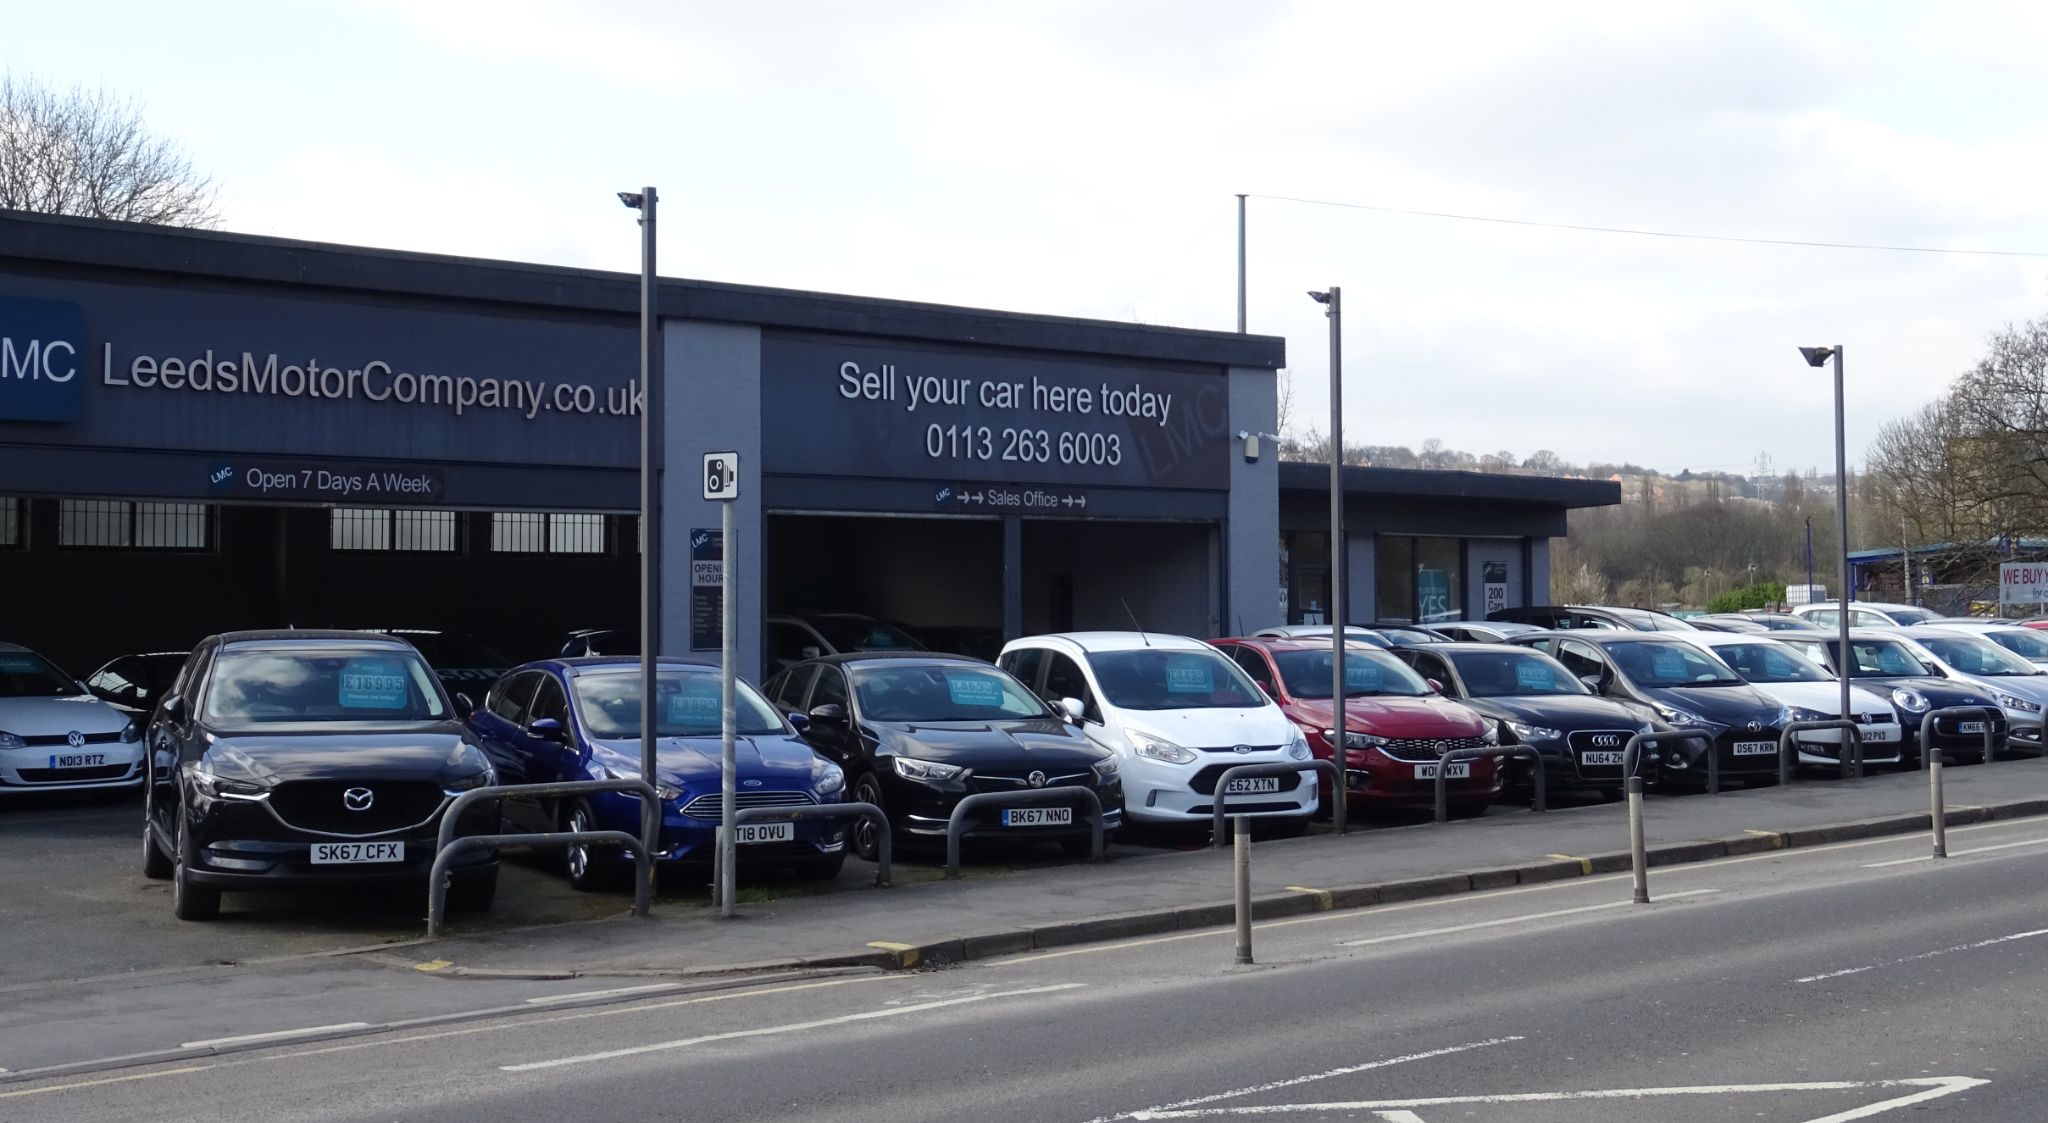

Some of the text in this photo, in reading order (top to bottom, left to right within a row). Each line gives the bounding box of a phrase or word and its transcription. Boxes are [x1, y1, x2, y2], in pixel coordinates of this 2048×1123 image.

[1, 337, 76, 382] MC
[104, 342, 642, 420] LeedsMotorCompany.co.uk
[839, 361, 1171, 427] Sell your car here today
[926, 423, 1122, 466] 0113 263 6003
[211, 467, 233, 484] LMC
[246, 468, 431, 495] Open 7 Days A Week
[987, 489, 1058, 507] Sales Office
[698, 574, 723, 583] HOUR
[2003, 568, 2019, 585] WE
[2022, 568, 2044, 585] BUY
[1488, 587, 1504, 599] 200
[1487, 601, 1505, 611] Cars
[1737, 743, 1758, 753] DS67
[59, 755, 105, 766] ND13 RTZ
[1585, 753, 1623, 763] NU64 ZH
[1229, 779, 1274, 791] E62 XTN
[1011, 809, 1070, 823] BK67 NNO
[735, 825, 785, 841] T18 OVU
[318, 843, 398, 860] SK67 CFX
